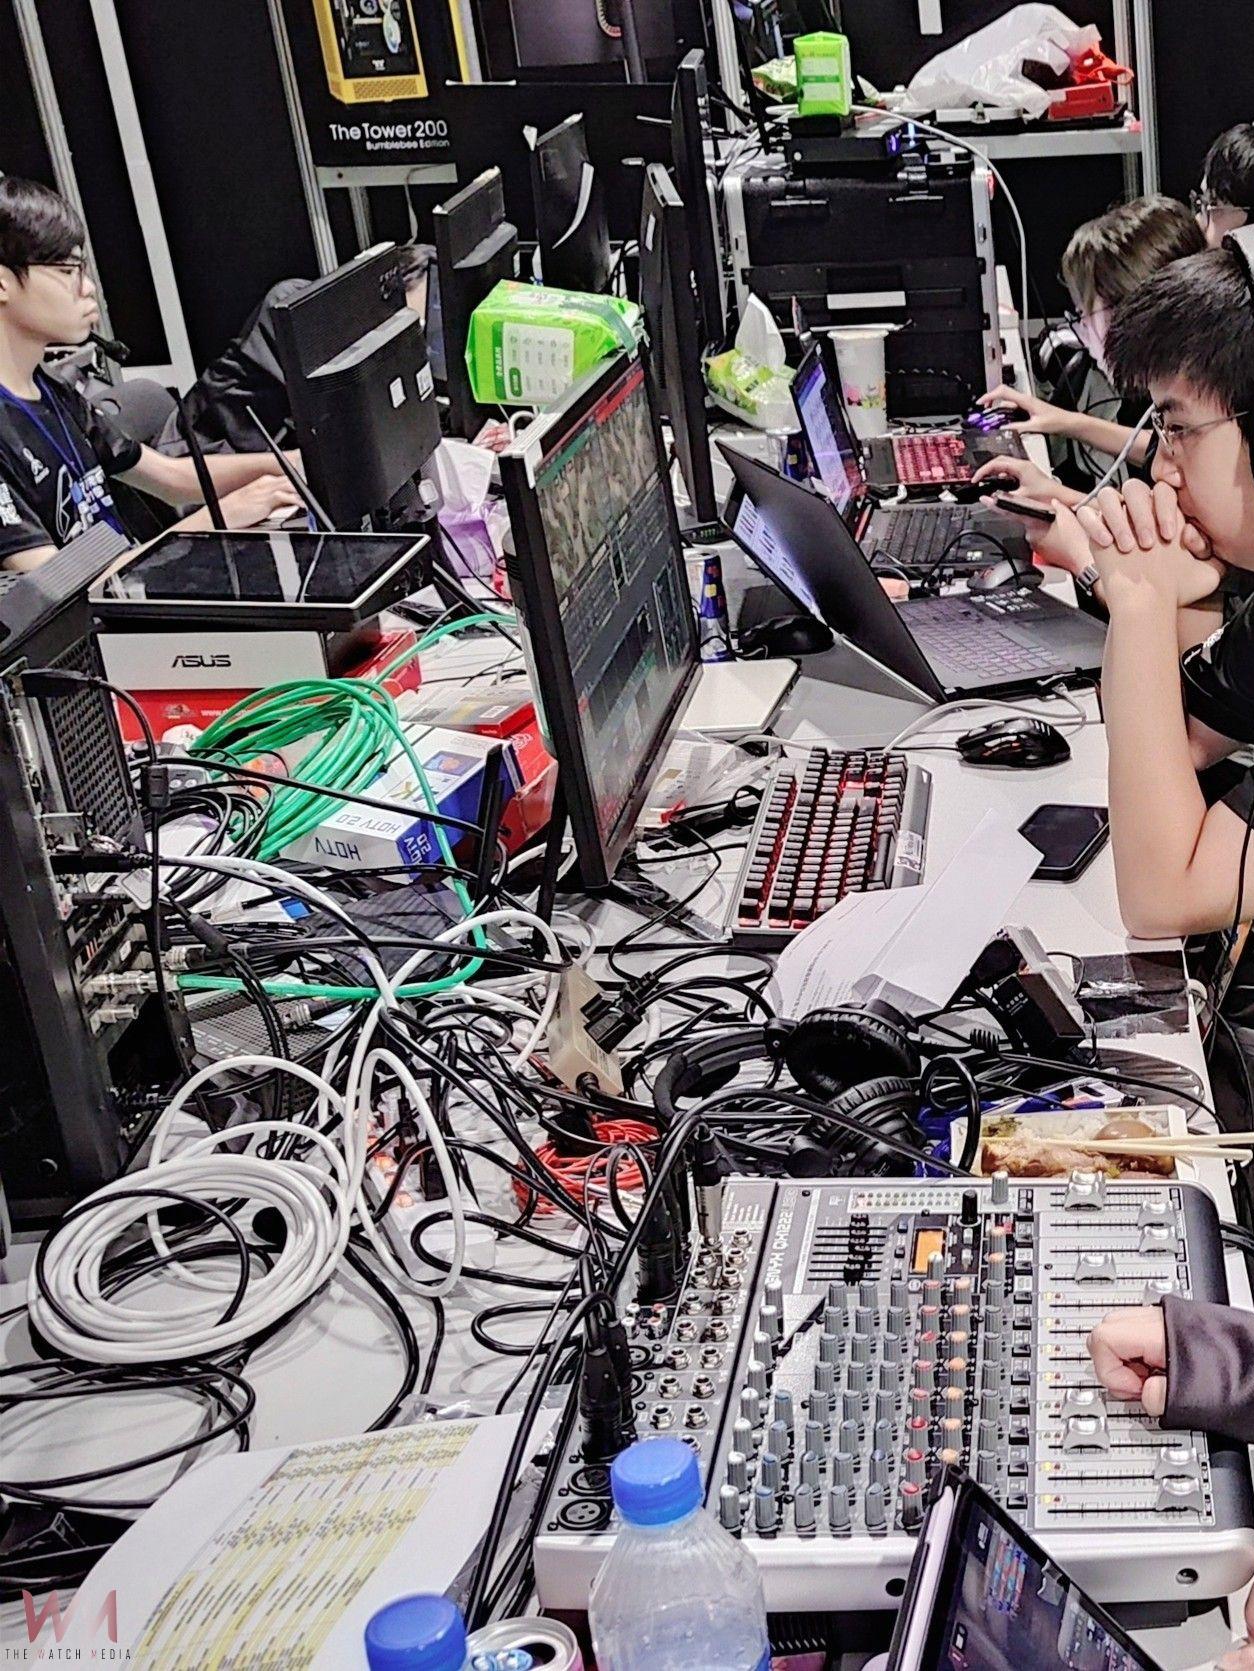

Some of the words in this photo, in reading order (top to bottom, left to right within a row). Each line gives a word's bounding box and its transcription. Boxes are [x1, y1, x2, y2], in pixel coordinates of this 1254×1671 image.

[329, 123, 361, 141] The
[362, 122, 412, 140] Tower
[414, 119, 448, 138] 200
[366, 140, 418, 151] Bumblebee
[172, 654, 232, 668] ASUS
[360, 817, 402, 835] HDTV
[314, 836, 362, 862] HDTV
